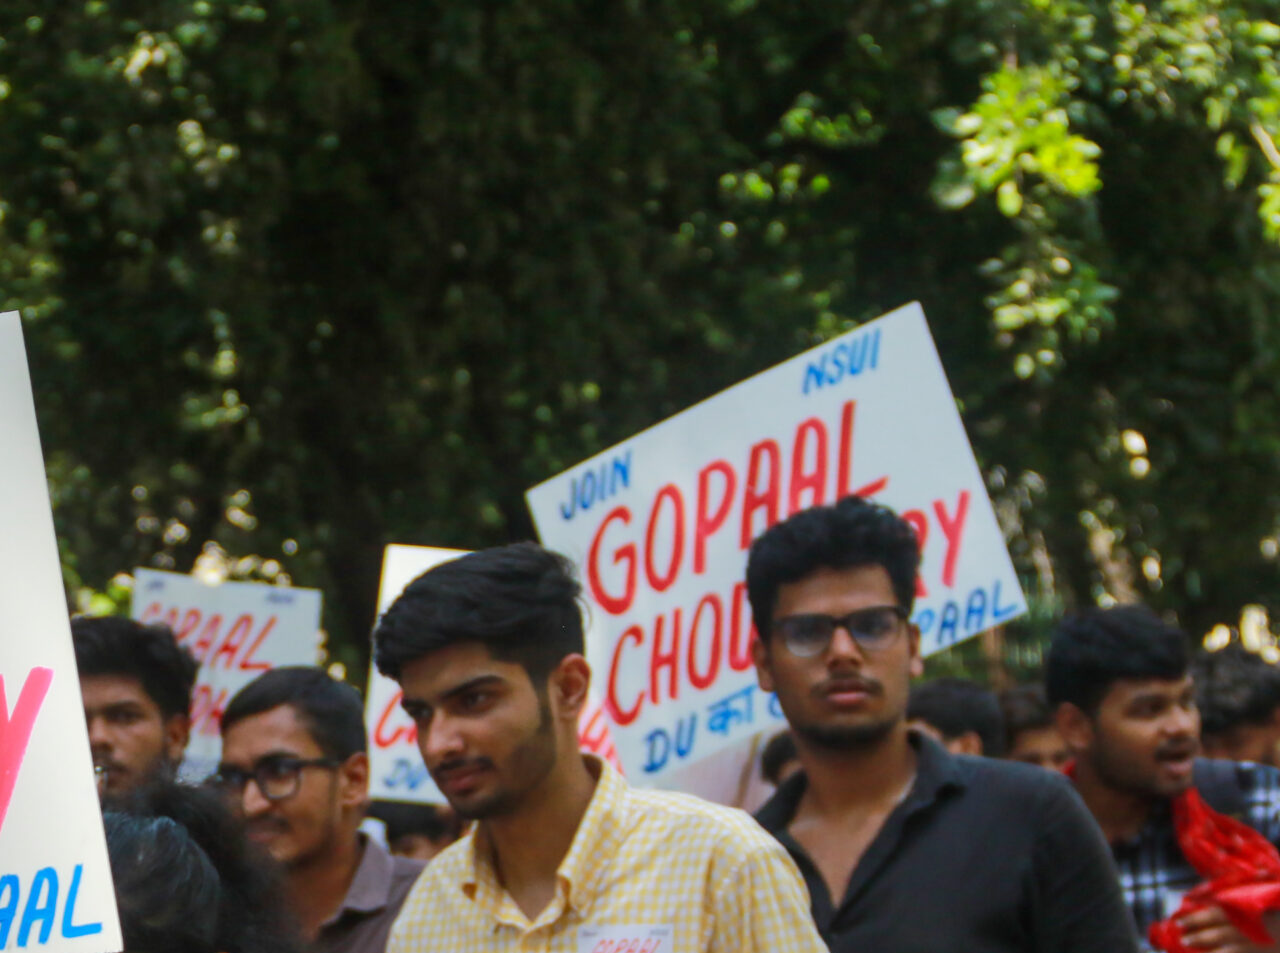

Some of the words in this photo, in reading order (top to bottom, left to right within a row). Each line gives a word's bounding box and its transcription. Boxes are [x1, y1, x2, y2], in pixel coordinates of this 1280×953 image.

[561, 451, 632, 521] JOIN
[802, 328, 882, 395] NSUI
[586, 400, 888, 616] GOPAAL
[642, 712, 698, 775] DU
[704, 682, 756, 735] का
[917, 580, 1019, 646] PAAL
